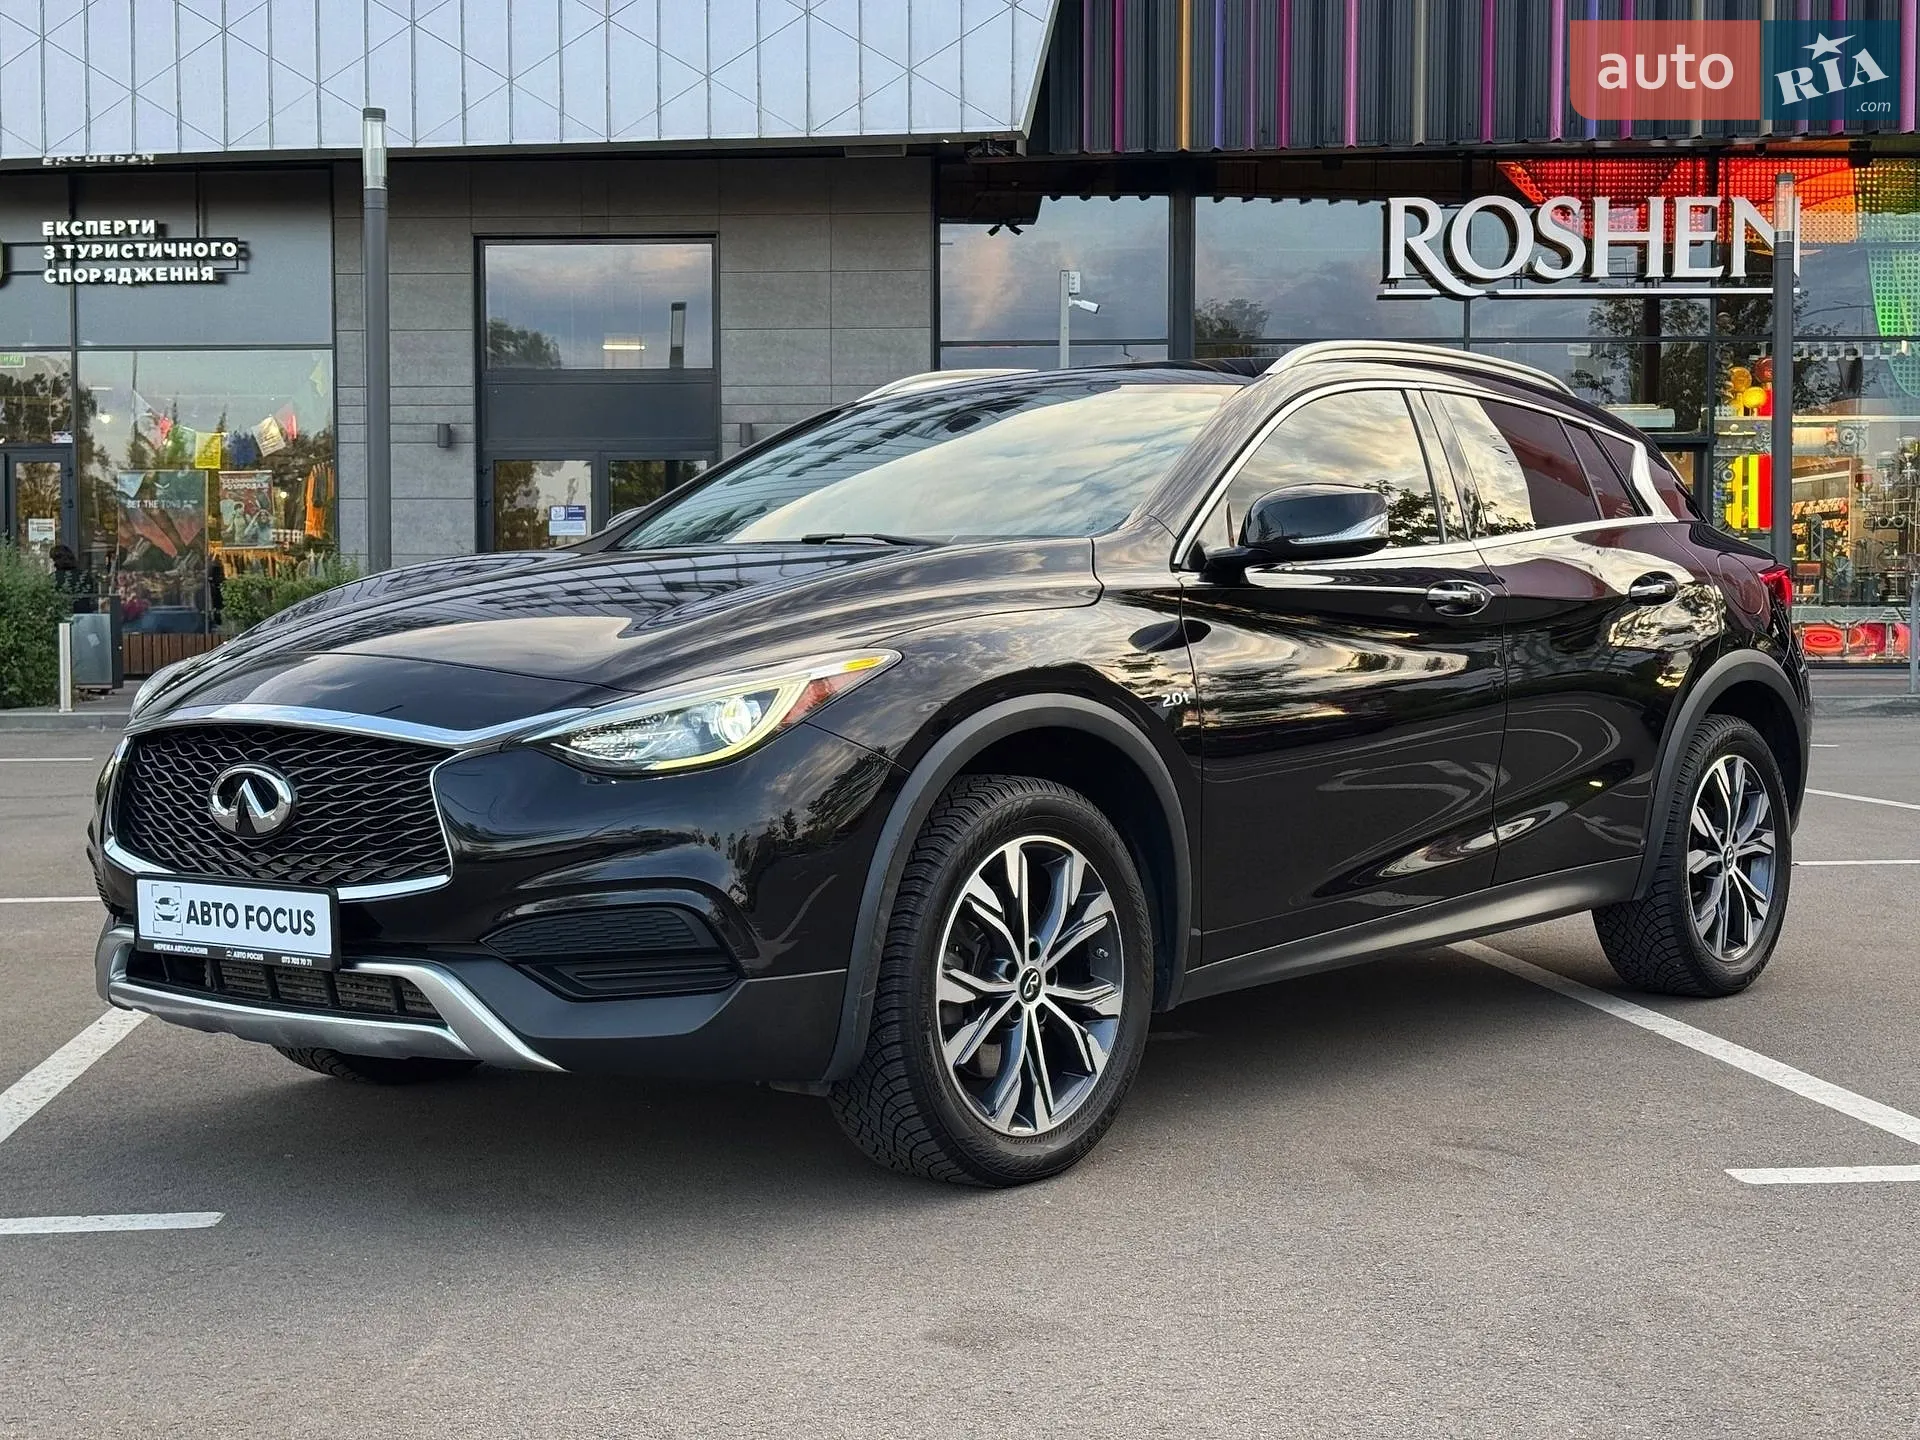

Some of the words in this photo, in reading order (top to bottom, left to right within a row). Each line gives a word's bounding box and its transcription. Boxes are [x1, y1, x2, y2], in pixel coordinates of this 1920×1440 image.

[42, 219, 156, 236] ЕКСПЕРТИ
[43, 244, 56, 260] З
[62, 241, 238, 260] ТУРИСТИЧНОГО
[1386, 195, 1801, 297] ROSHEN
[43, 266, 215, 285] СПОРЯДЖЕННЯ
[186, 899, 239, 929] АВТО
[244, 904, 316, 937] FOCUS
